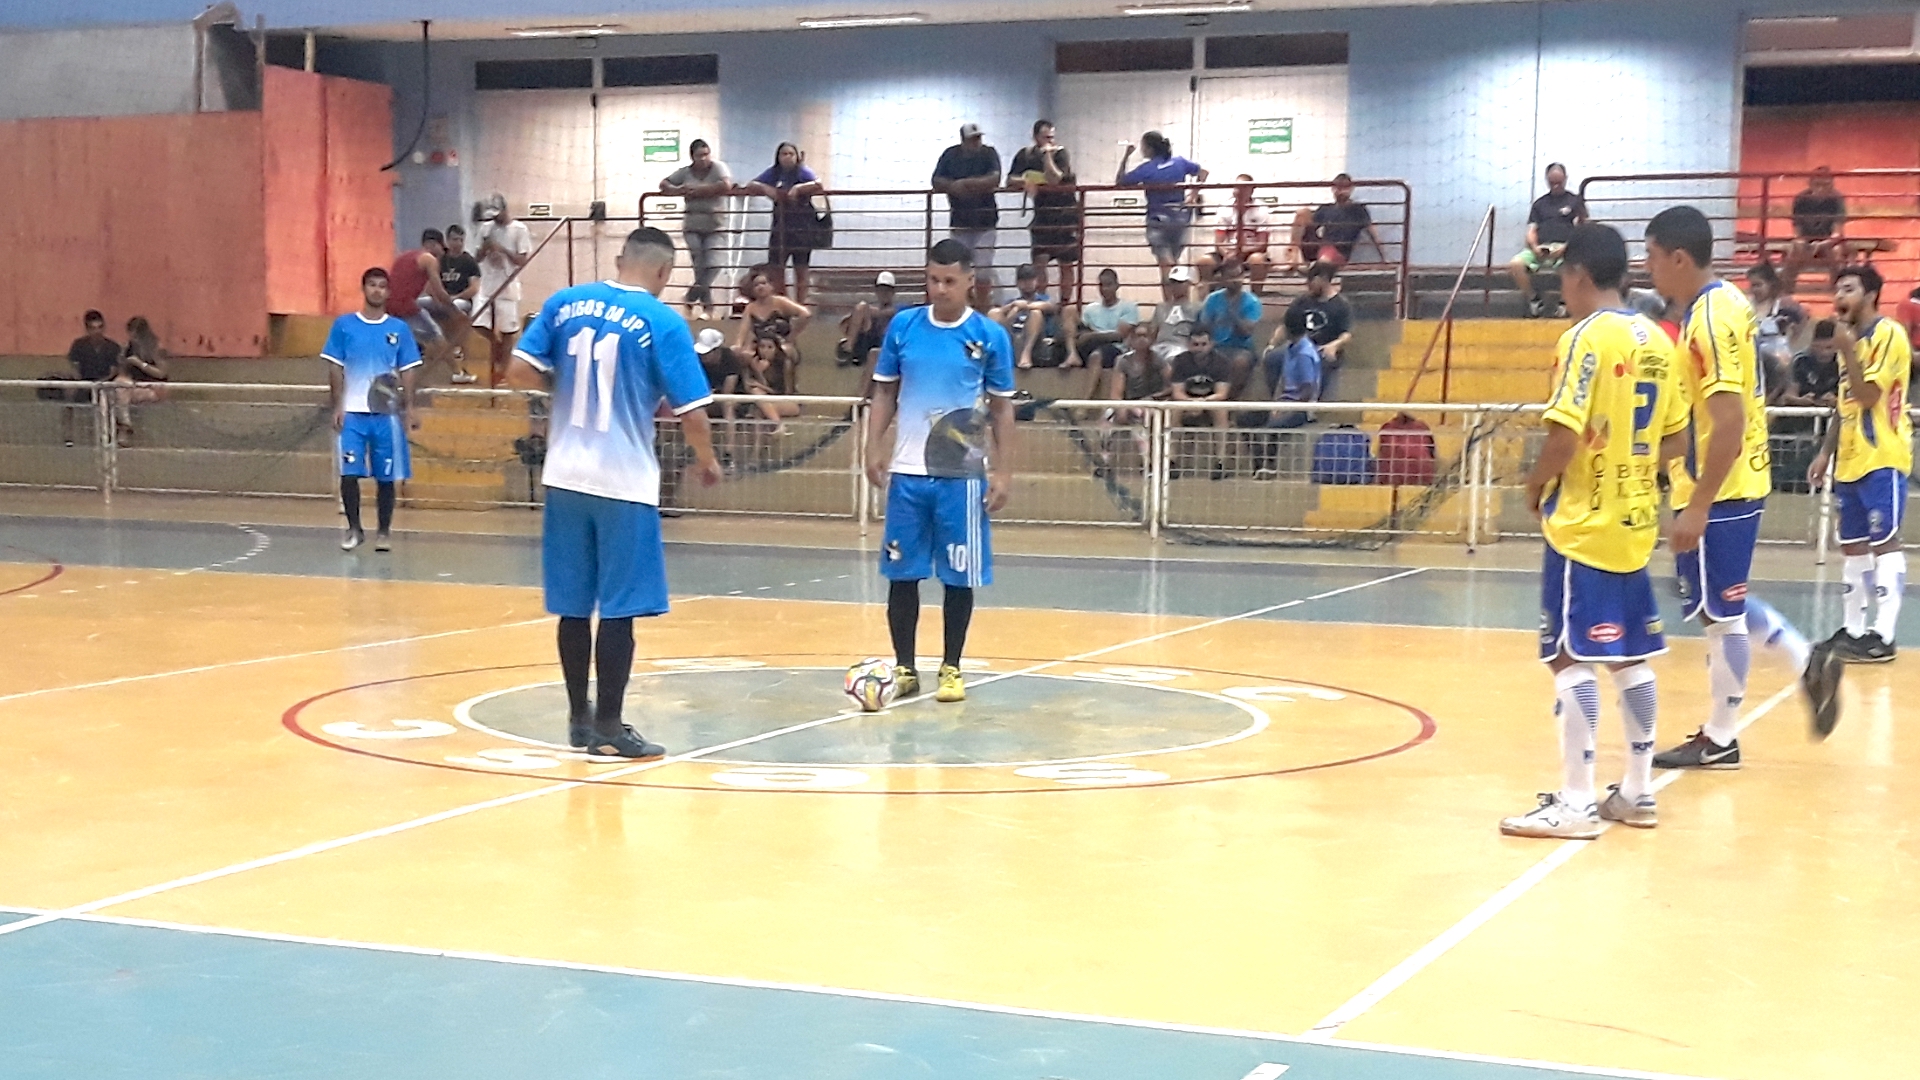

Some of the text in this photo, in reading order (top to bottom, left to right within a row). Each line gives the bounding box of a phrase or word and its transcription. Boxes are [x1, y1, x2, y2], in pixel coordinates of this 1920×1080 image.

[621, 314, 646, 333] JP
[1165, 304, 1184, 325] A
[566, 326, 621, 434] 11
[1632, 381, 1658, 455] 2
[384, 458, 393, 476] 7
[945, 543, 967, 573] 10
